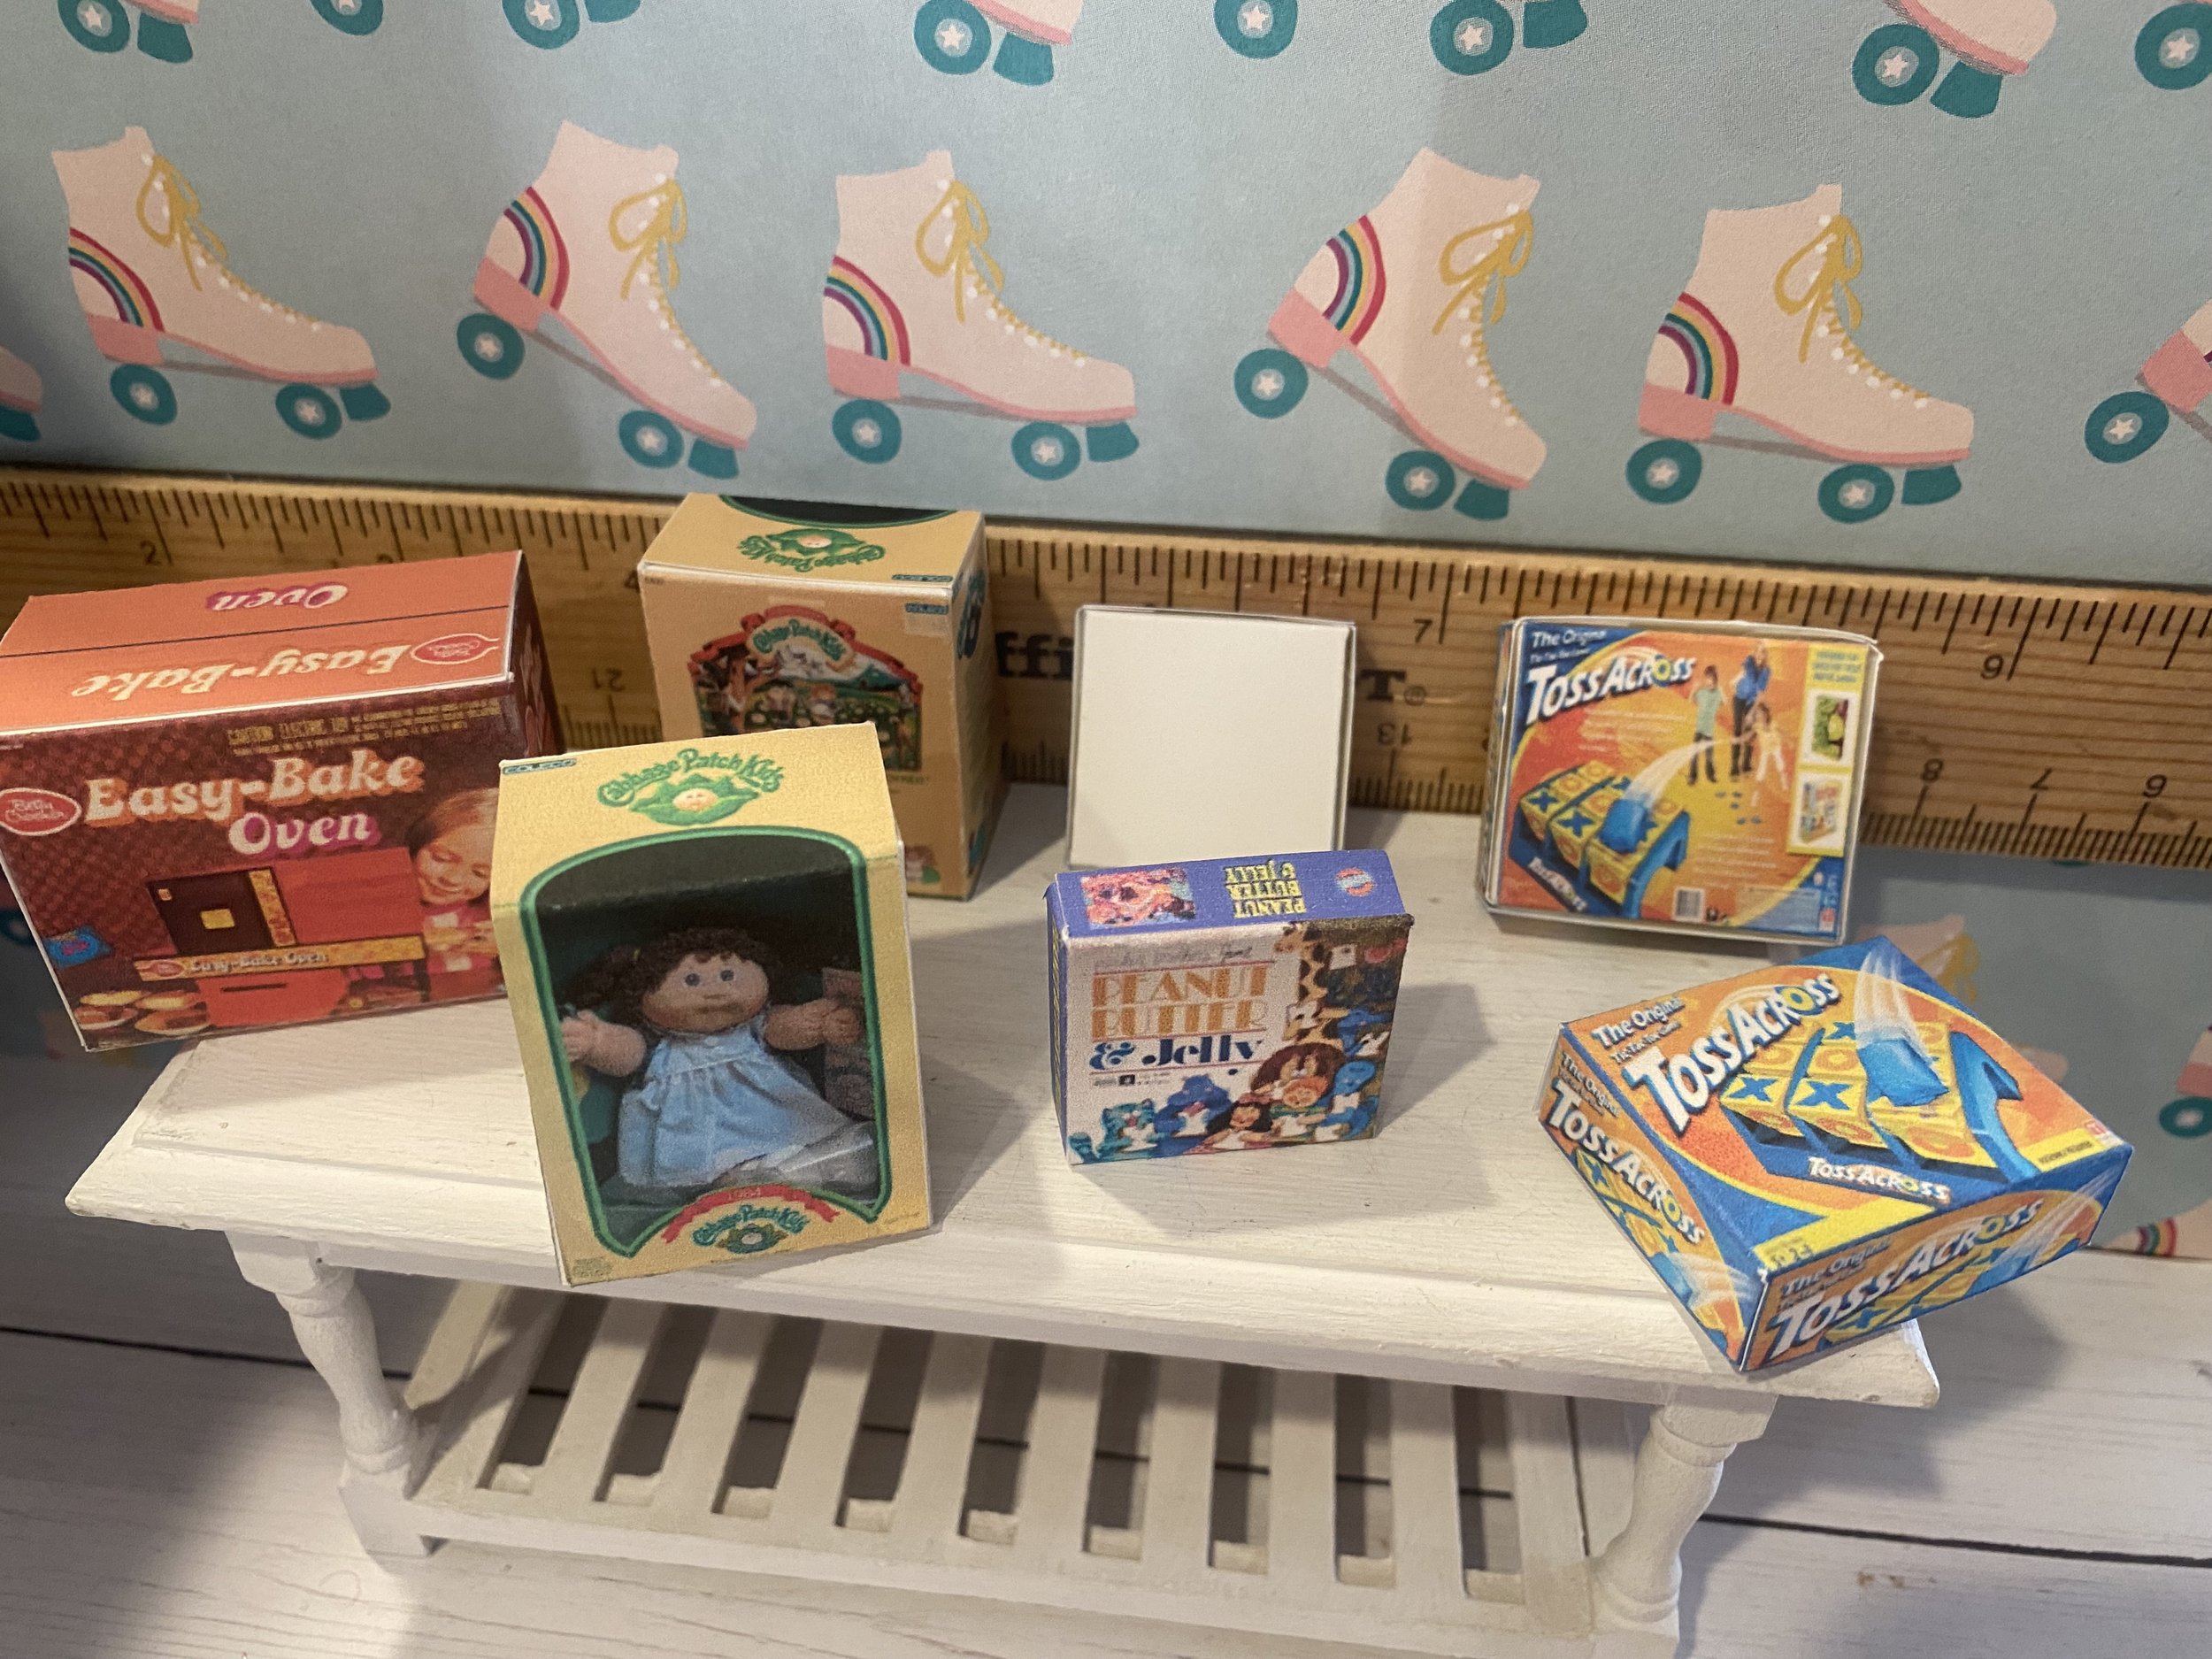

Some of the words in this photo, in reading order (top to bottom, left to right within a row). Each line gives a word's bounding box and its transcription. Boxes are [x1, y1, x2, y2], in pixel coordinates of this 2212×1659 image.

[140, 540, 161, 566] 2
[209, 582, 349, 612] Oven
[1413, 618, 1433, 644] 7
[1532, 630, 1559, 649] The
[72, 643, 413, 701] Easy-Bake
[1980, 653, 2005, 680] 9
[1919, 757, 1944, 783] 8
[2030, 767, 2054, 792] 7
[85, 747, 426, 826] Easy-Bake
[228, 811, 380, 857] Oven
[1225, 879, 1303, 901] BUTTER
[1233, 897, 1308, 918] PEANUT
[1092, 964, 1269, 1007] PEANUT
[1591, 1023, 1633, 1049] The
[1089, 1041, 1136, 1071] &
